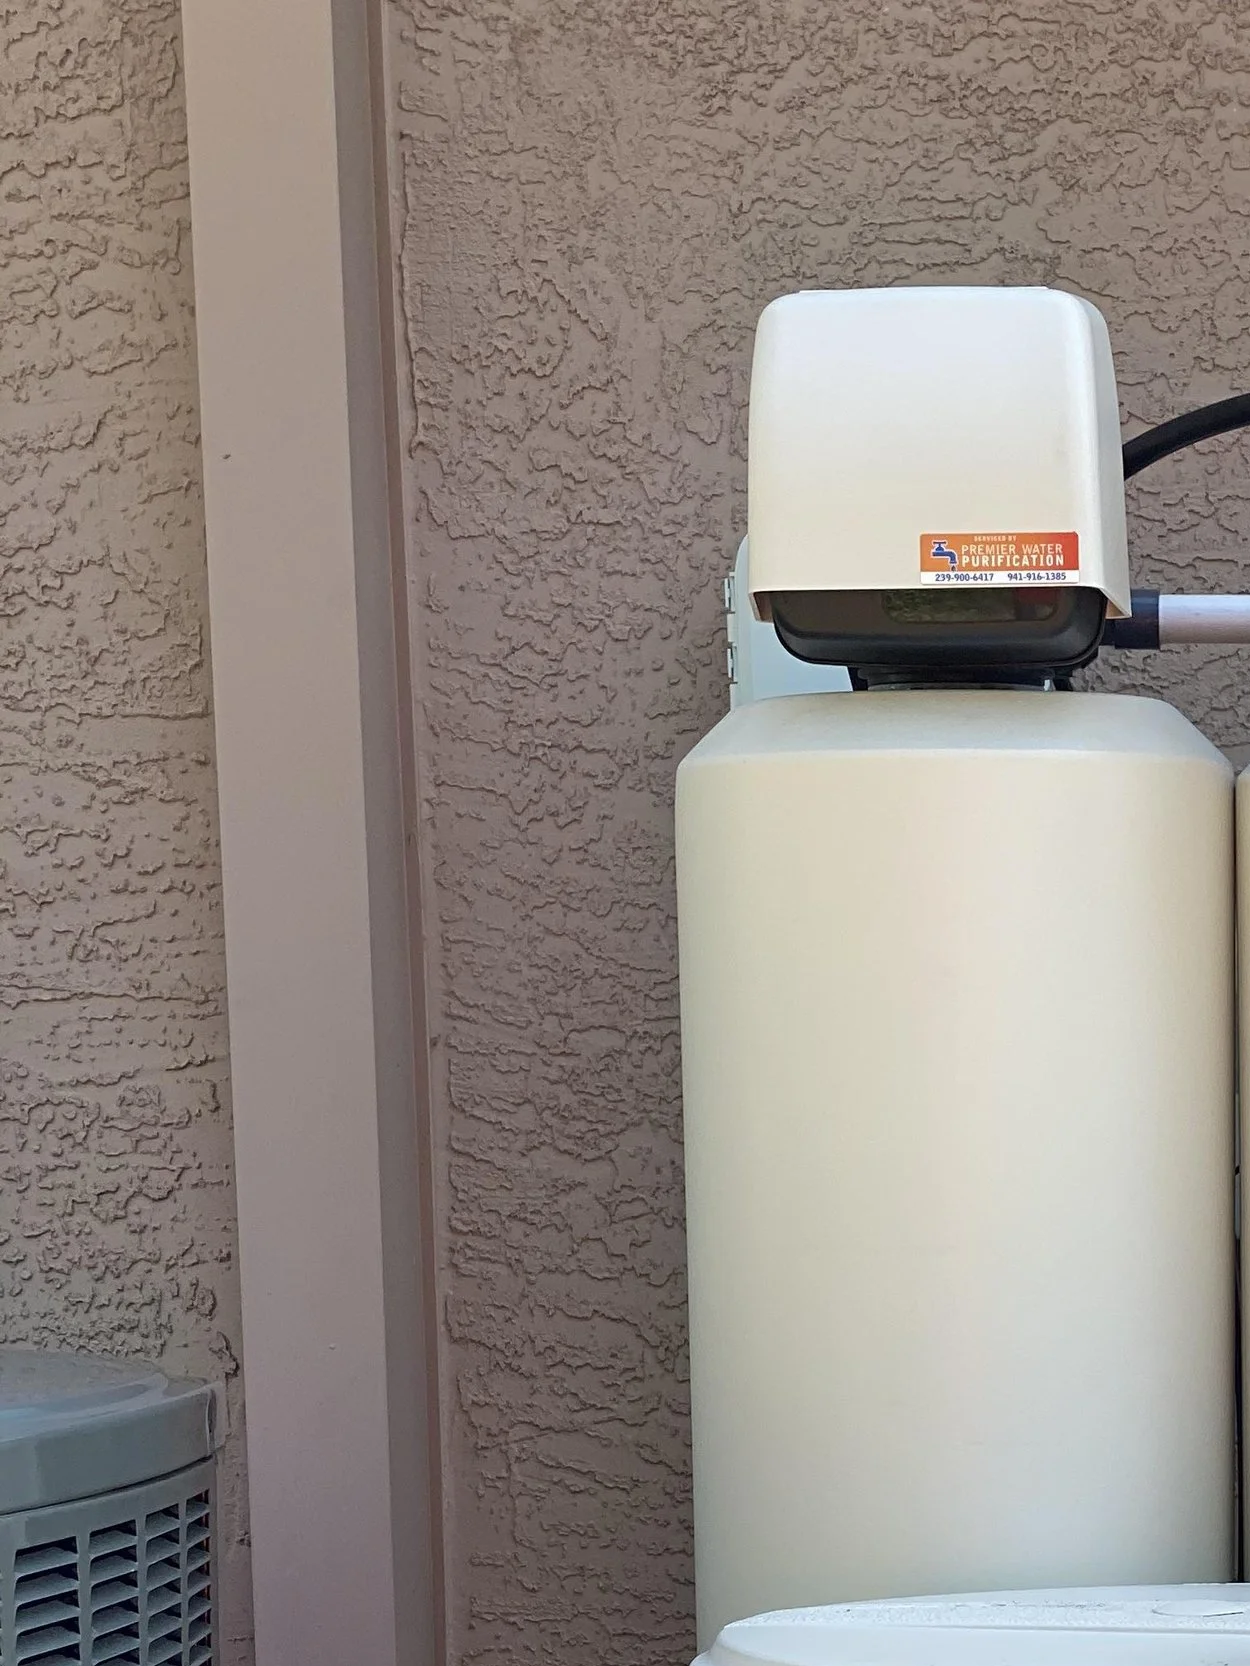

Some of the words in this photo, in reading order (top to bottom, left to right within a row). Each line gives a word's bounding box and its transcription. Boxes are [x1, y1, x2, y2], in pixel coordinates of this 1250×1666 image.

[961, 544, 1016, 555] PREMIER
[1022, 543, 1063, 554] WATER
[962, 554, 1064, 567] PURIFICATION
[935, 573, 994, 582] 239-900-6417
[1007, 572, 1067, 581] 941-916-1385
